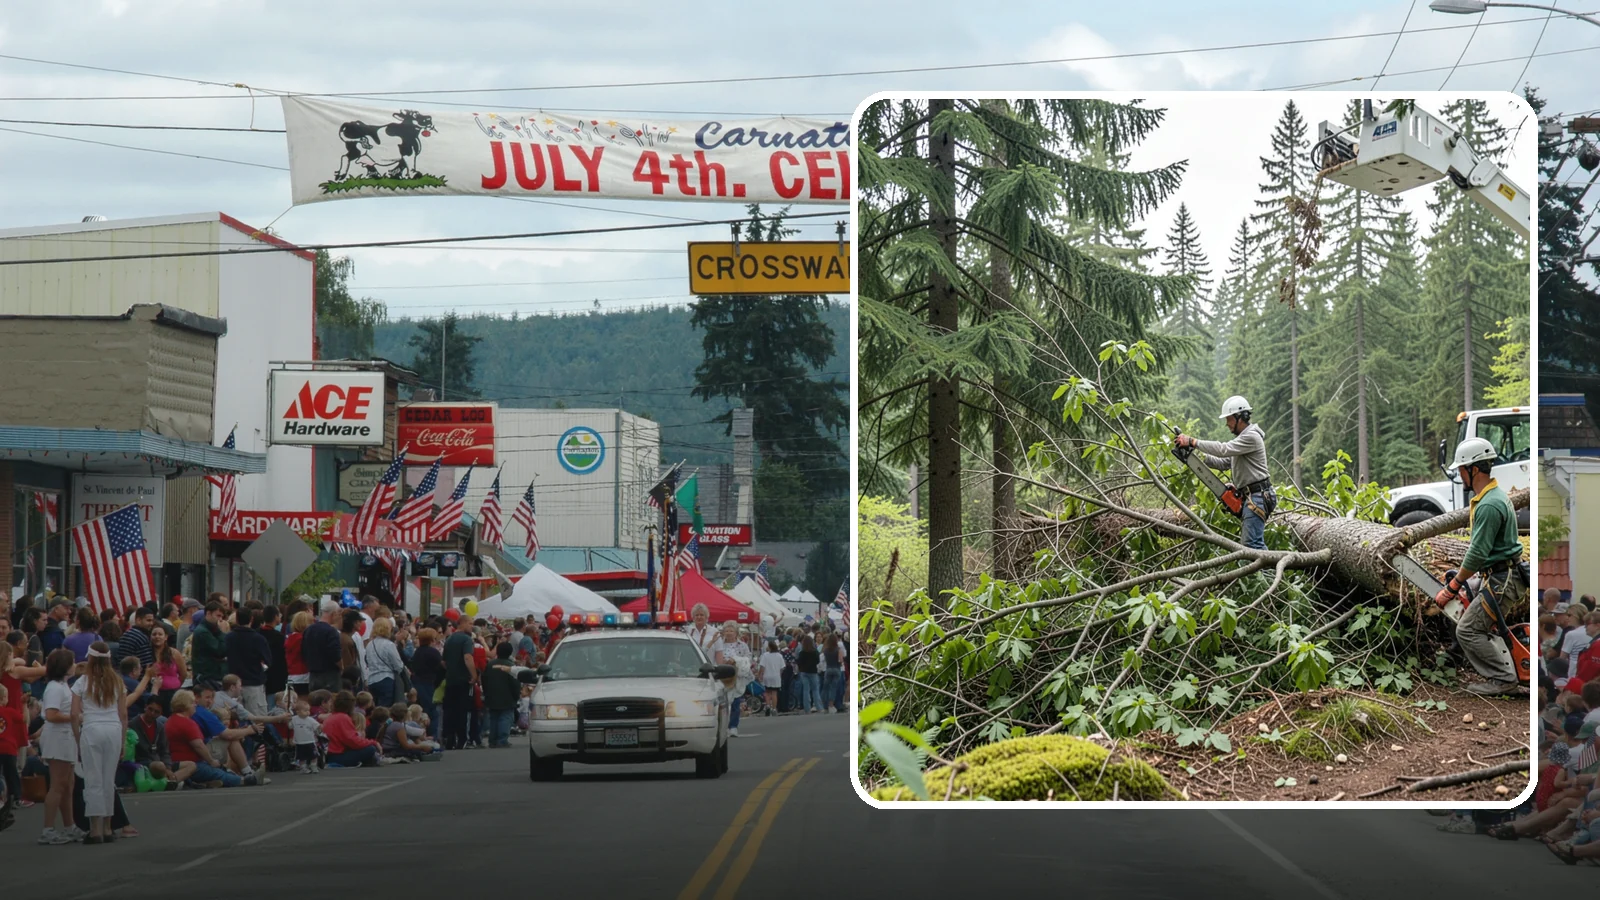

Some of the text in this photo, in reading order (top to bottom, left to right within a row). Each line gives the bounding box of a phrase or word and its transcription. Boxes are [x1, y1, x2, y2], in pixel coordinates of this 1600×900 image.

[694, 121, 850, 150] Carnat
[481, 141, 605, 192] JULY
[632, 150, 746, 198] 4th.
[696, 254, 850, 280] CROSSWA
[283, 380, 373, 420] ACE
[405, 409, 452, 421] CEDAR
[283, 421, 370, 436] Hardware
[416, 427, 476, 447] Coca-Cola
[353, 466, 385, 481] Simpl
[95, 485, 124, 494] Vincent
[126, 486, 135, 494] de
[137, 486, 155, 495] Paul
[688, 526, 742, 535] CRNATION
[699, 535, 730, 543] GLASS
